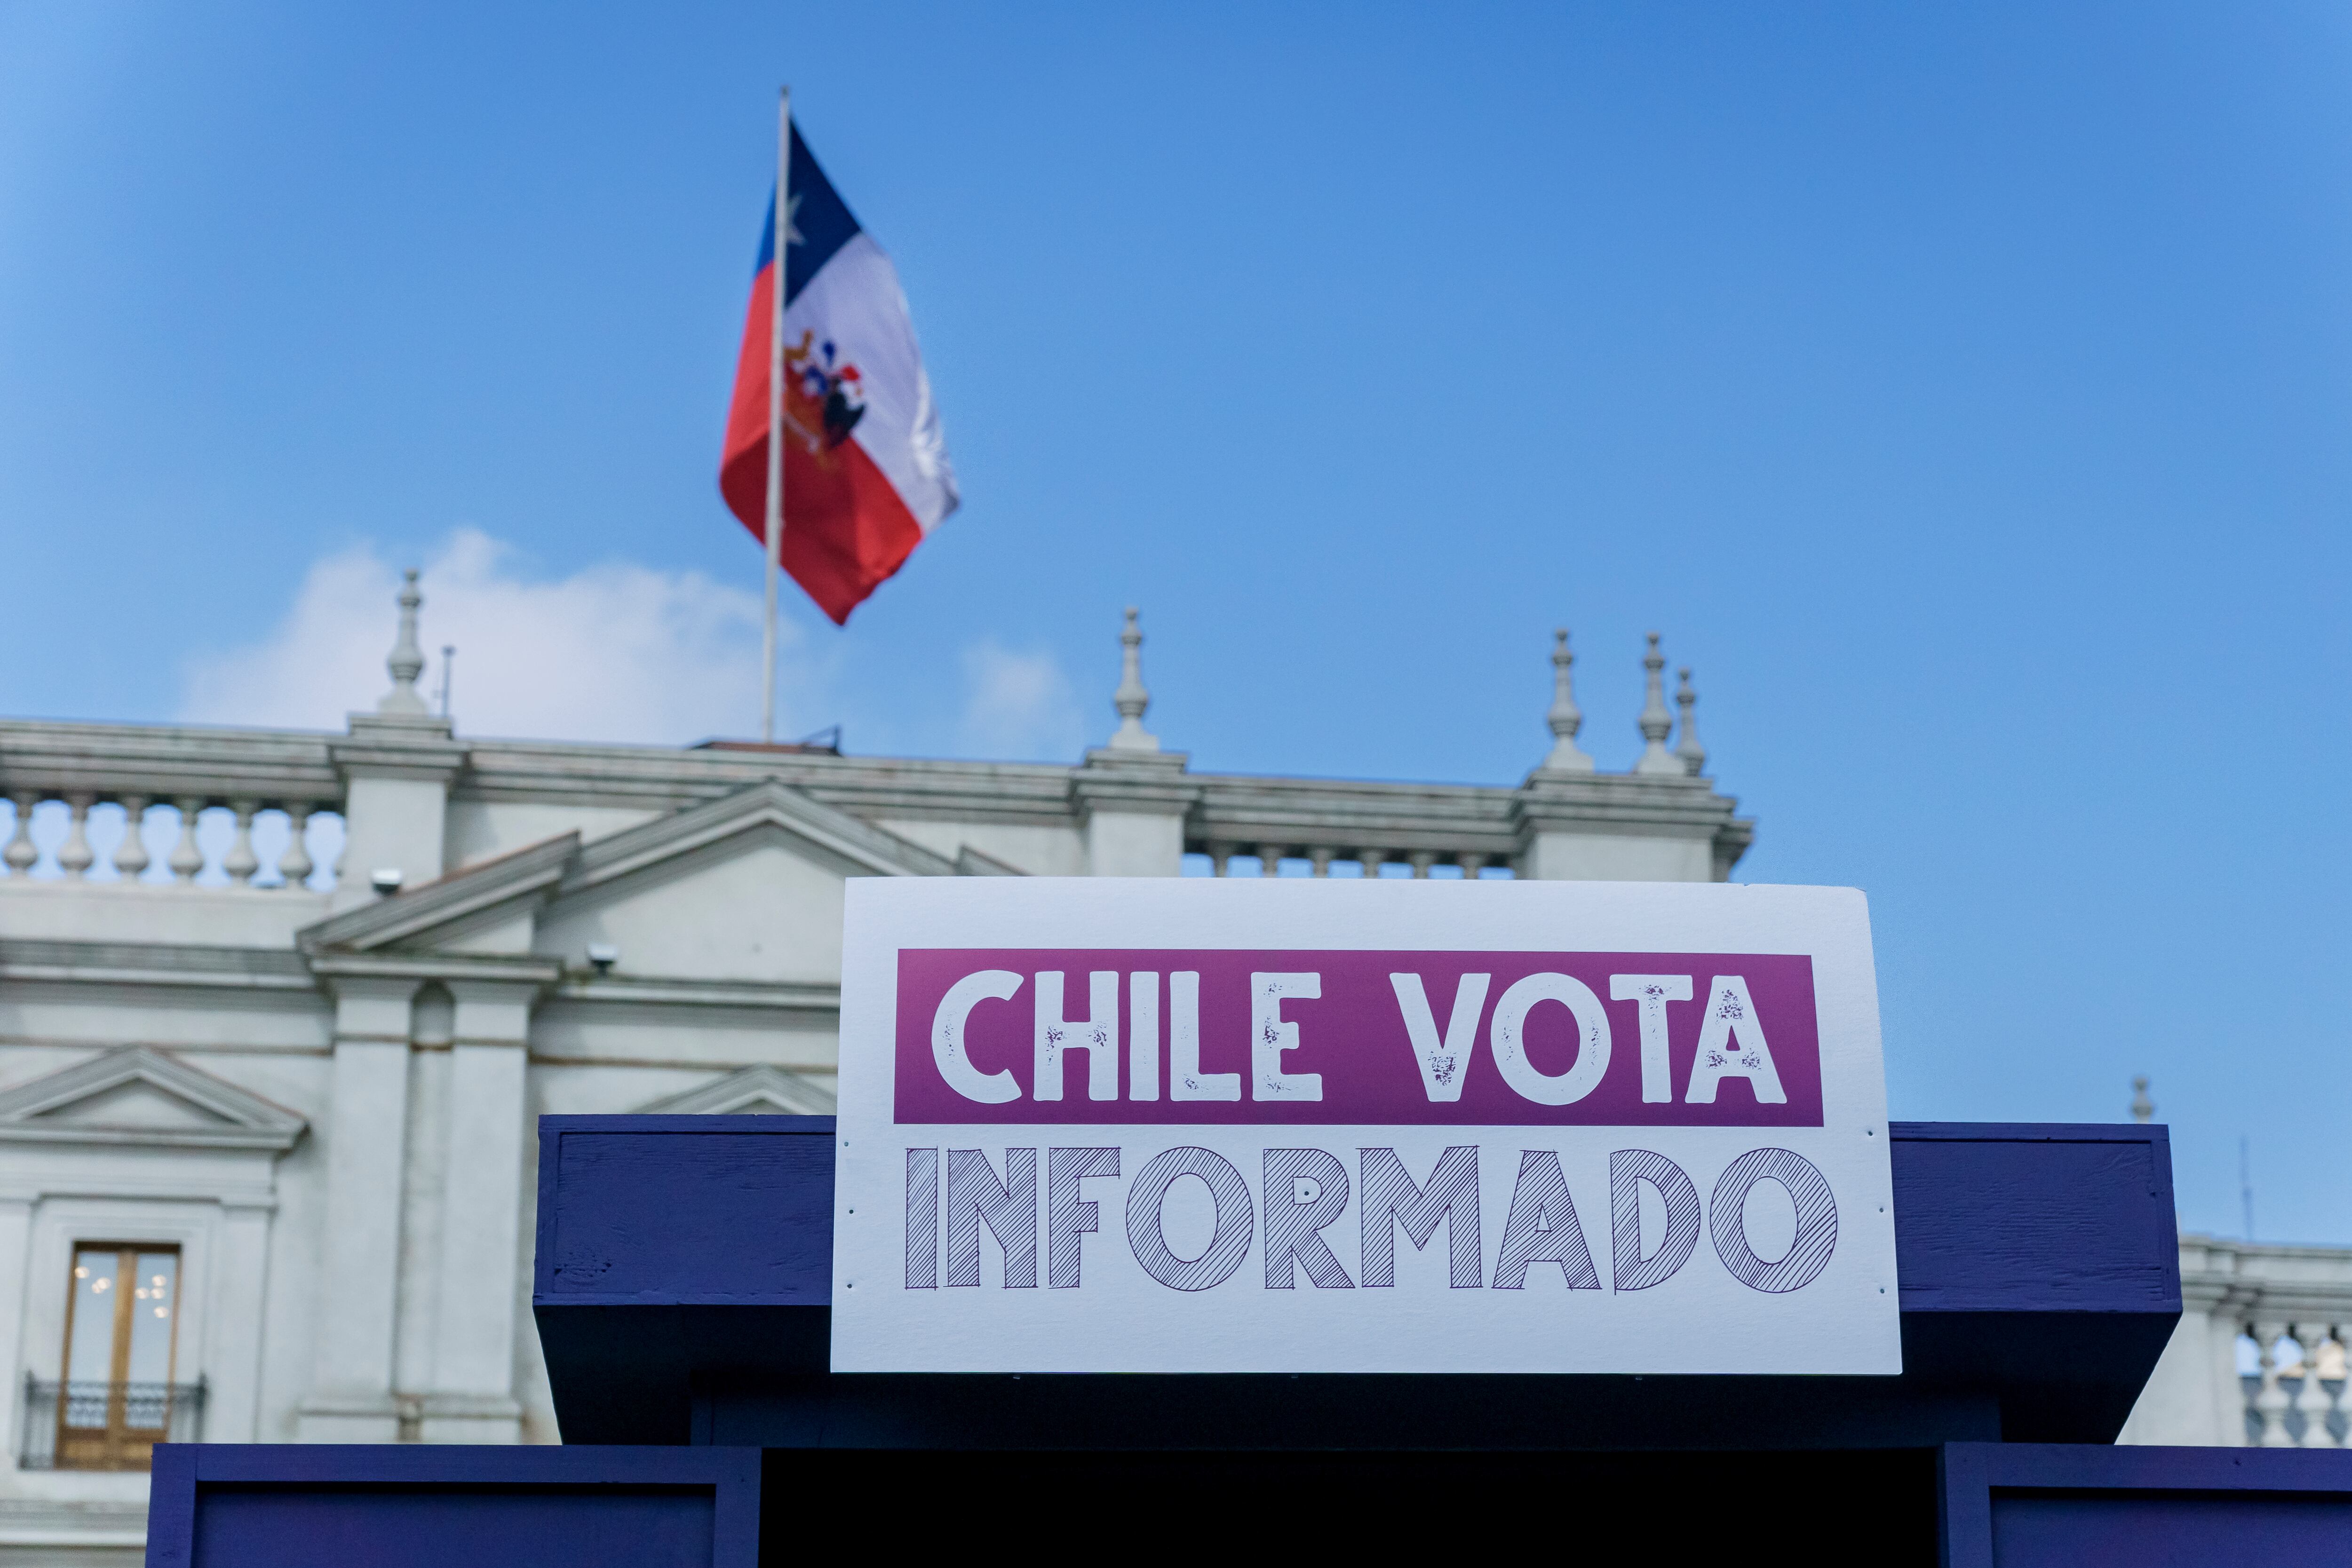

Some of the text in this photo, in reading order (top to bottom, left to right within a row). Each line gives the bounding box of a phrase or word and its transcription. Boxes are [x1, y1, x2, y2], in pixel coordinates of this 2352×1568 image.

[931, 970, 1788, 1105] CHILE VOTA
[905, 1146, 1838, 1294] INFORMADO
